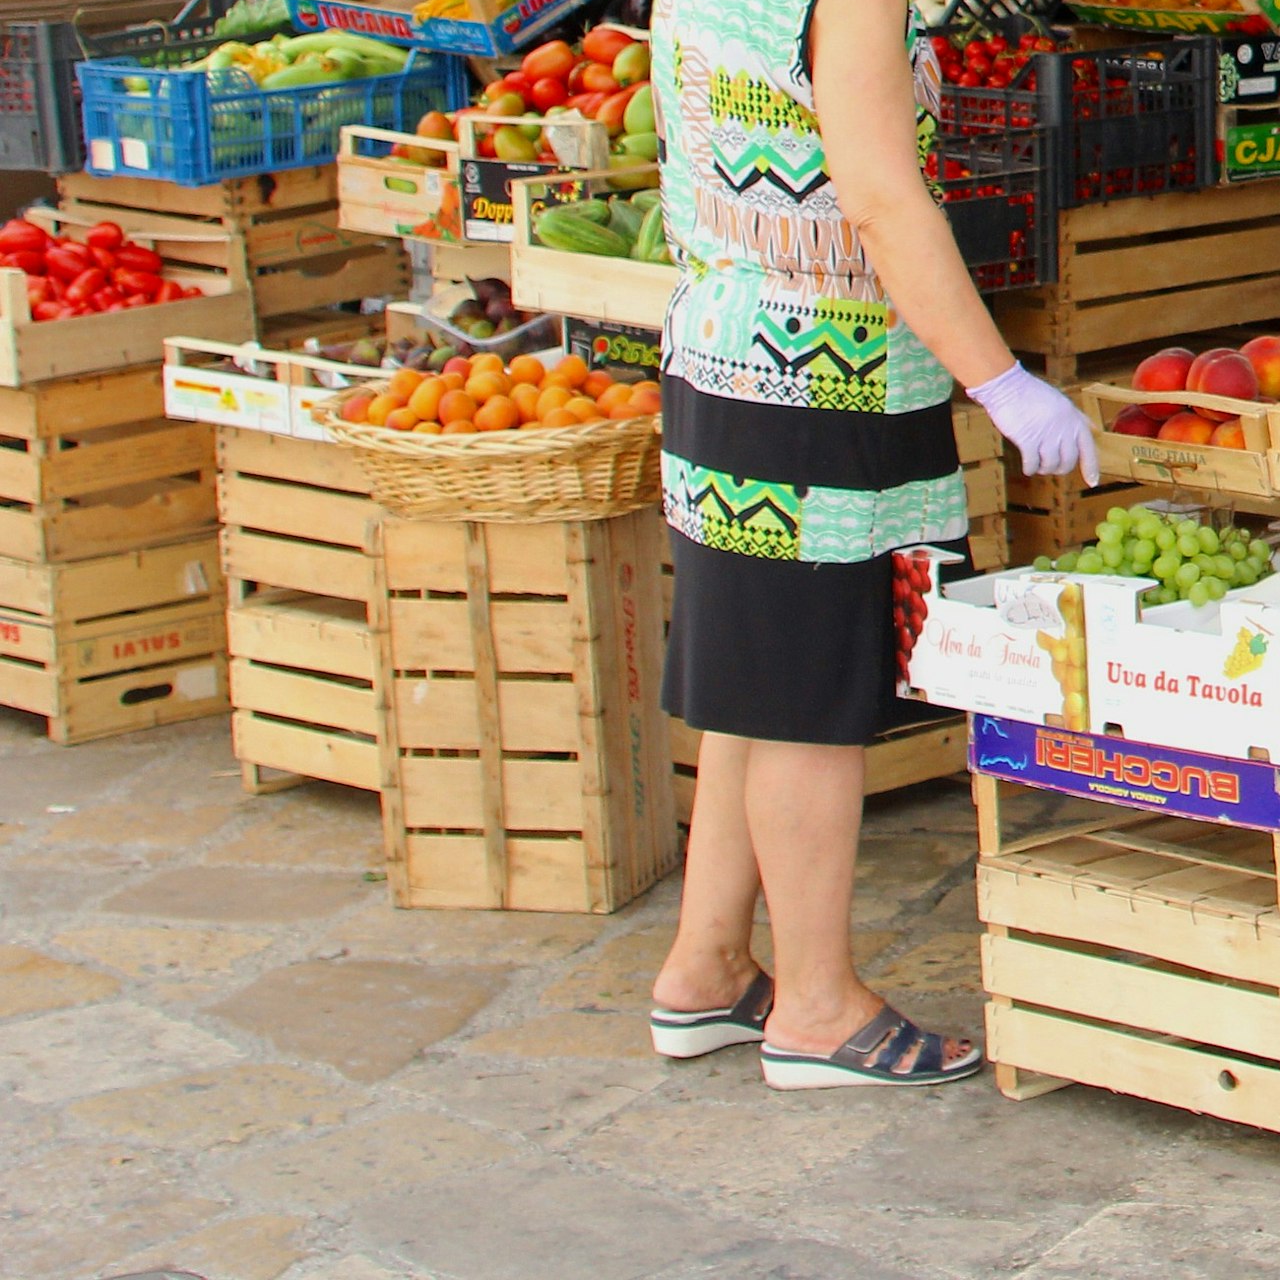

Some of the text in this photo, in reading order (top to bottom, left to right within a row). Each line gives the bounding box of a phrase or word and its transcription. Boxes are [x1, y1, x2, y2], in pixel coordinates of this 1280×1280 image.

[319, 4, 414, 39] LUCANA
[1103, 8, 1220, 34] CJAPI
[112, 631, 182, 660] SALVI
[926, 617, 1041, 669] Uva da Tavola
[1107, 661, 1263, 708] Uva da Tavola
[1035, 738, 1241, 804] BUCCHERI
[1088, 782, 1168, 805] AZIENDA AGRICOLA
